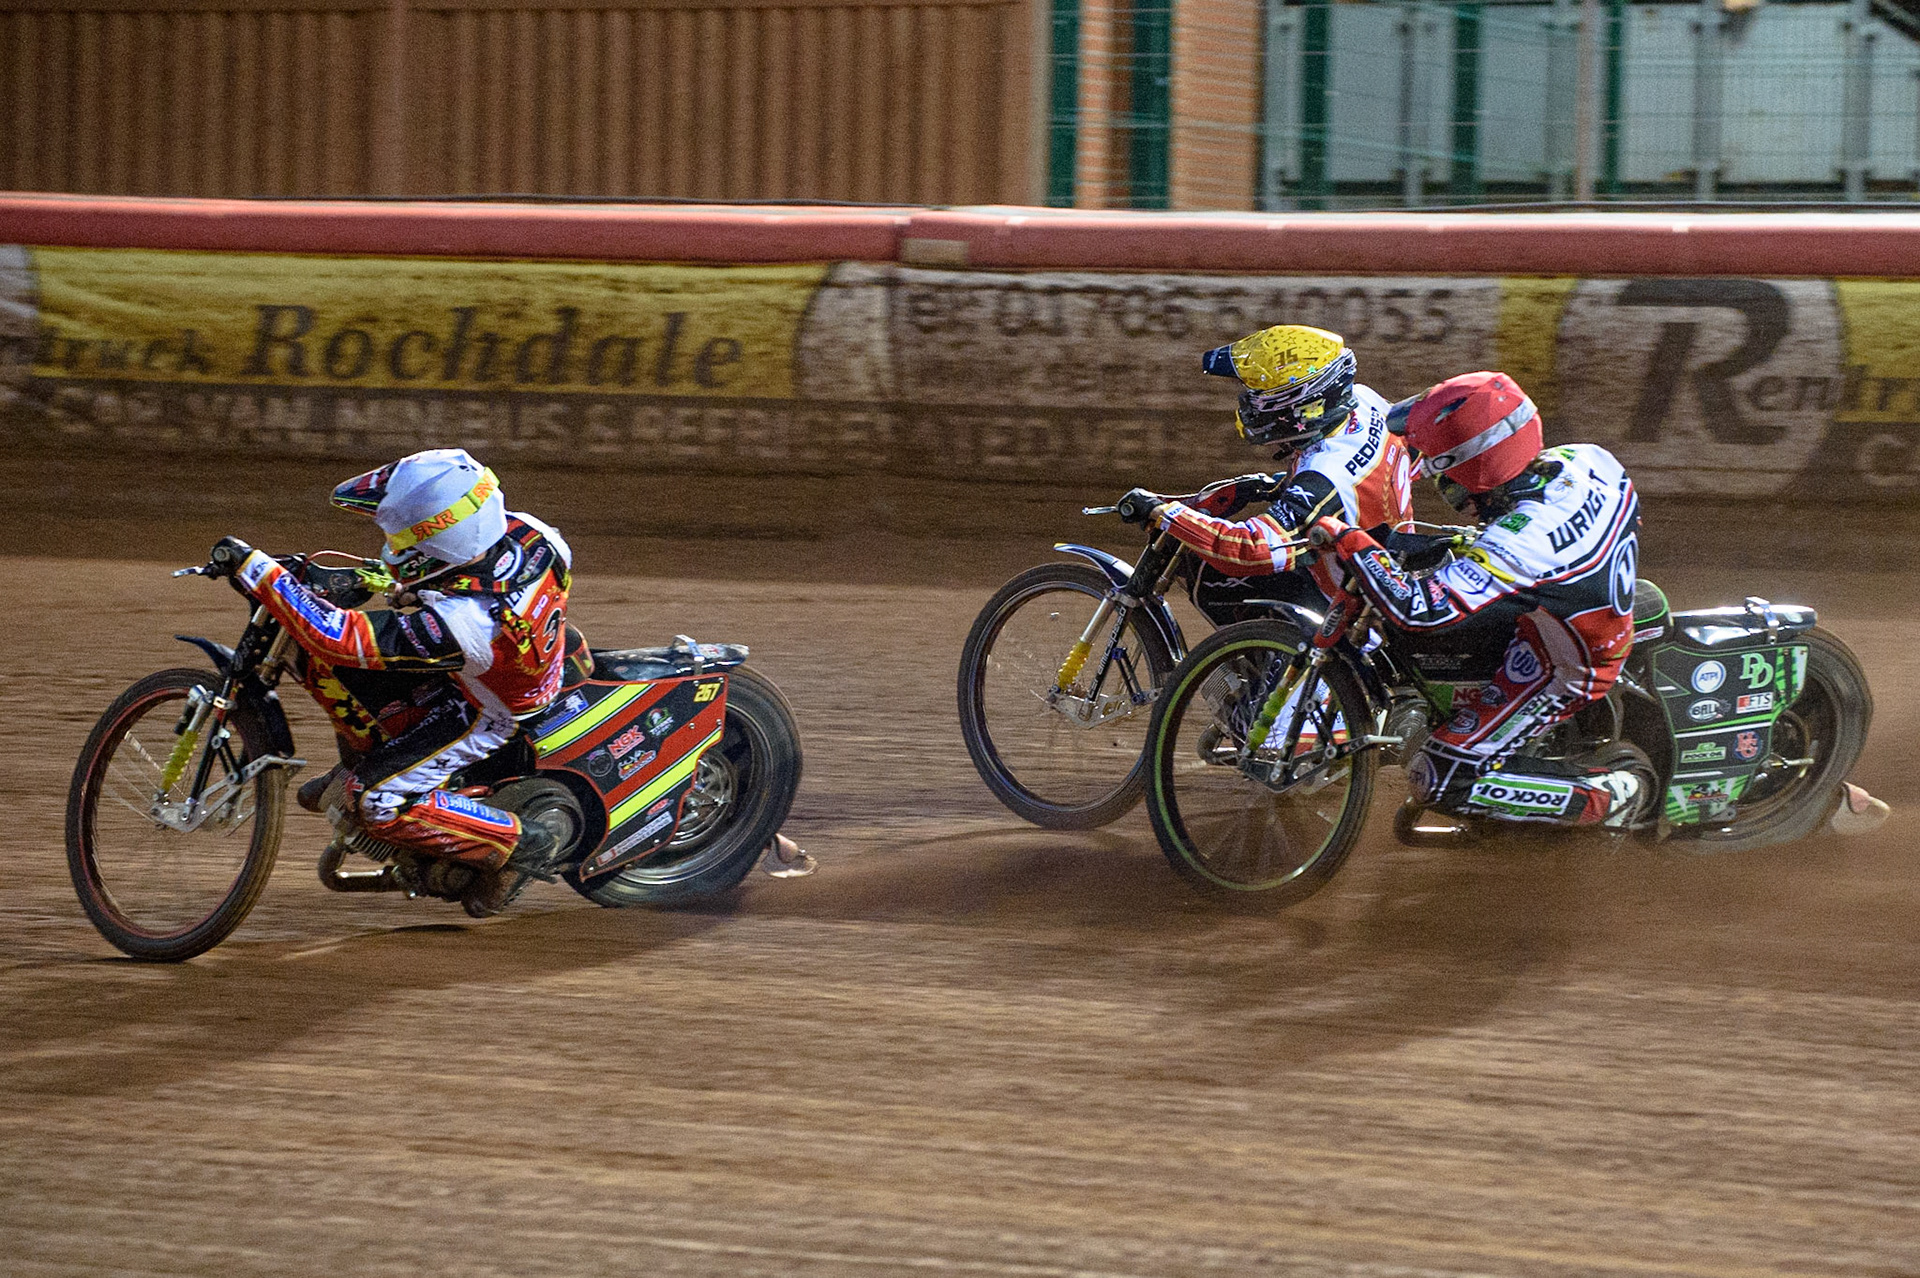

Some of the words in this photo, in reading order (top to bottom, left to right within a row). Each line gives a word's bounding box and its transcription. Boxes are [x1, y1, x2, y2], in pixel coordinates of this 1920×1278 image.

[240, 303, 742, 389] Rochdale
[693, 683, 721, 703] 267
[1749, 692, 1772, 706] FTS
[608, 725, 643, 755] NGK
[1508, 789, 1568, 807] ROCK
